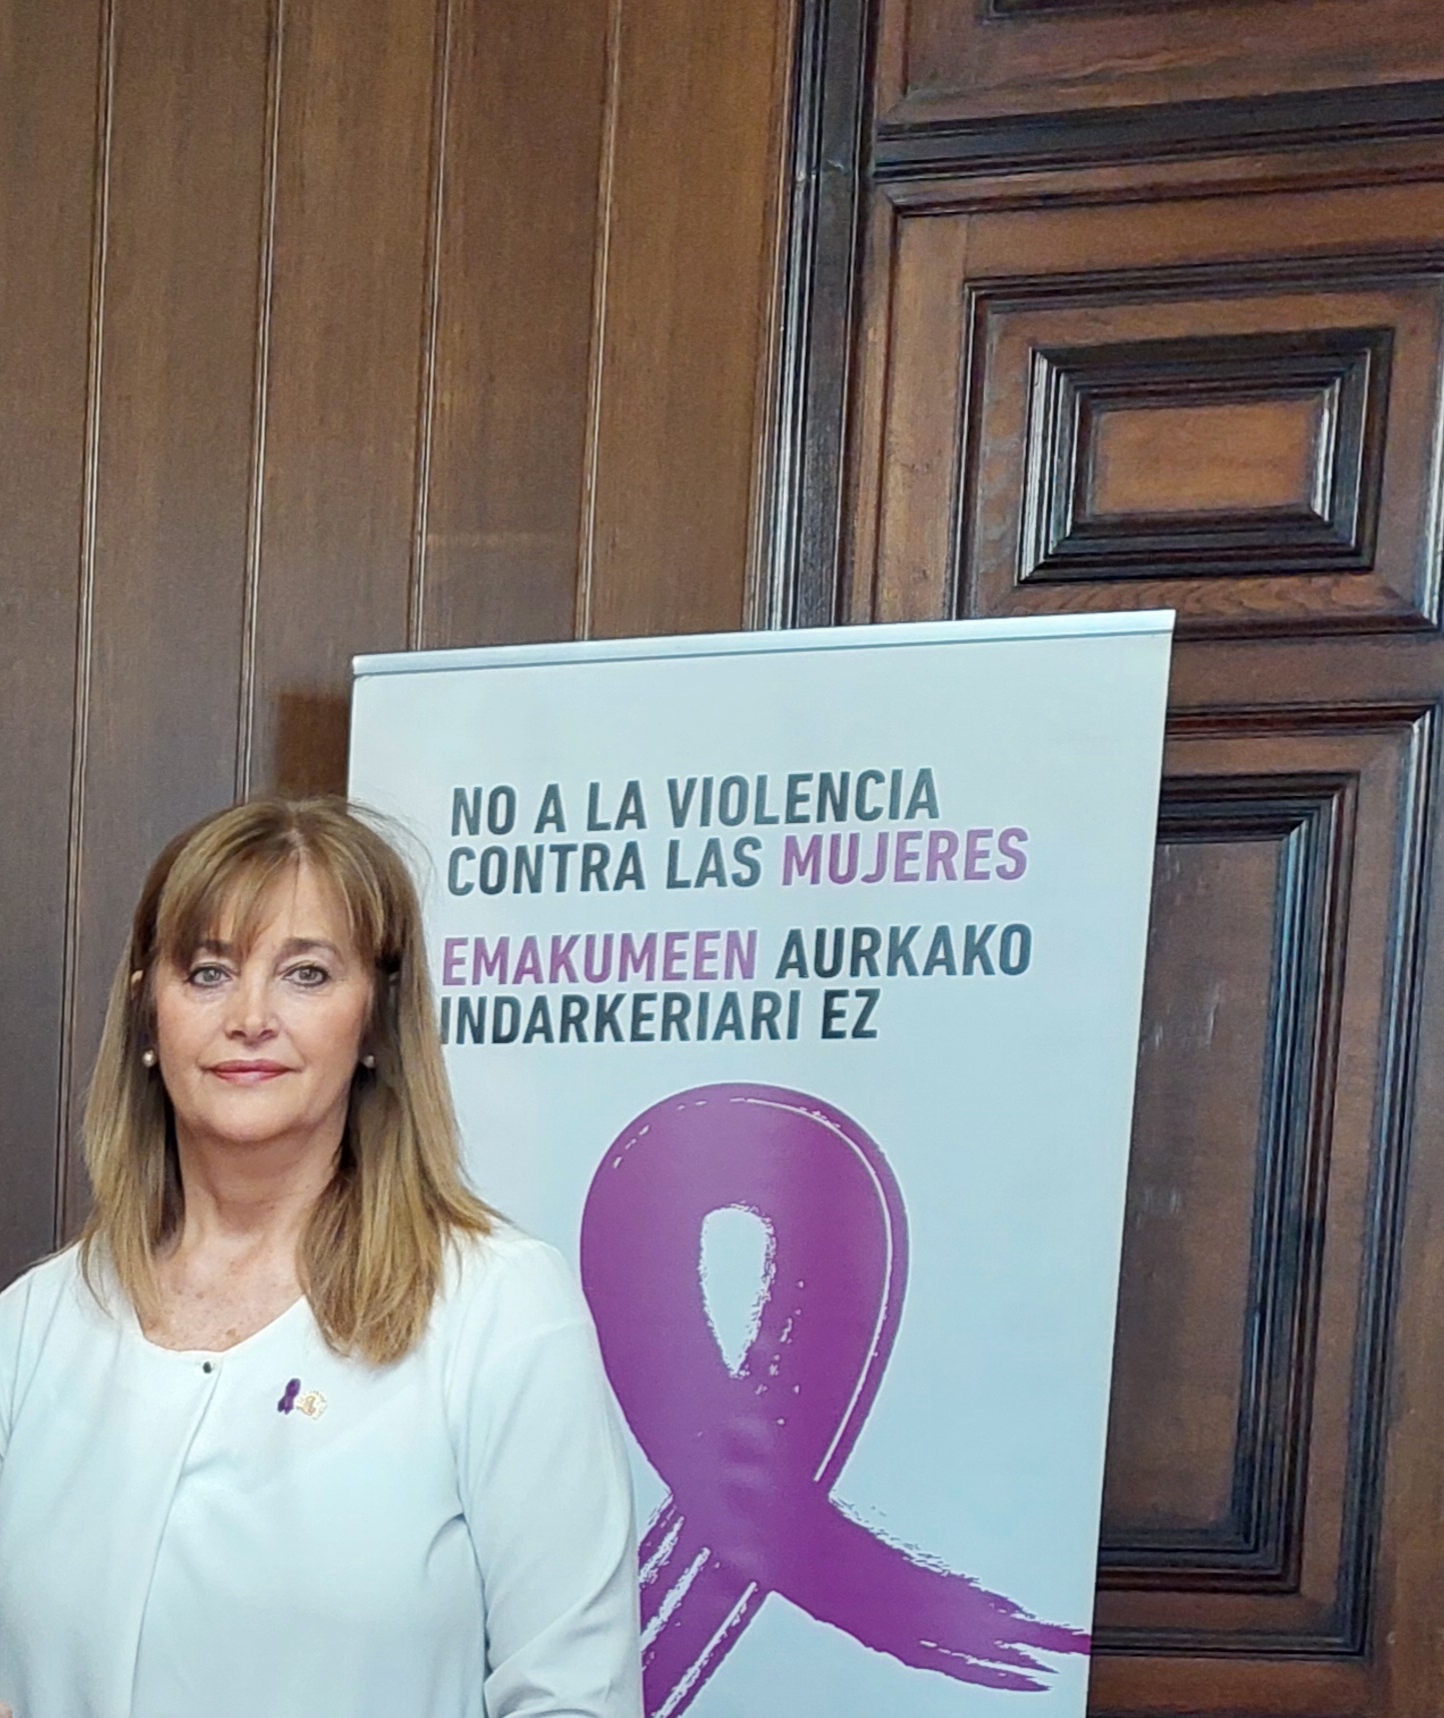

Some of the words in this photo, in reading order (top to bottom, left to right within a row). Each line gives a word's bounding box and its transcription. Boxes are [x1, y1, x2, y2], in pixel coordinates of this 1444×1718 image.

[451, 785, 517, 837] NO
[534, 783, 566, 833] A
[586, 779, 647, 831] LA
[666, 767, 940, 829] VIOLENCIA
[447, 840, 646, 896] CONTRA
[666, 835, 763, 889] LAS
[781, 827, 1028, 886] MUJERES
[442, 929, 757, 986] EMAKUMEEN
[775, 923, 1031, 980] AURKAKO
[440, 989, 801, 1045] INDARKERIARI
[821, 987, 881, 1041] EZ
